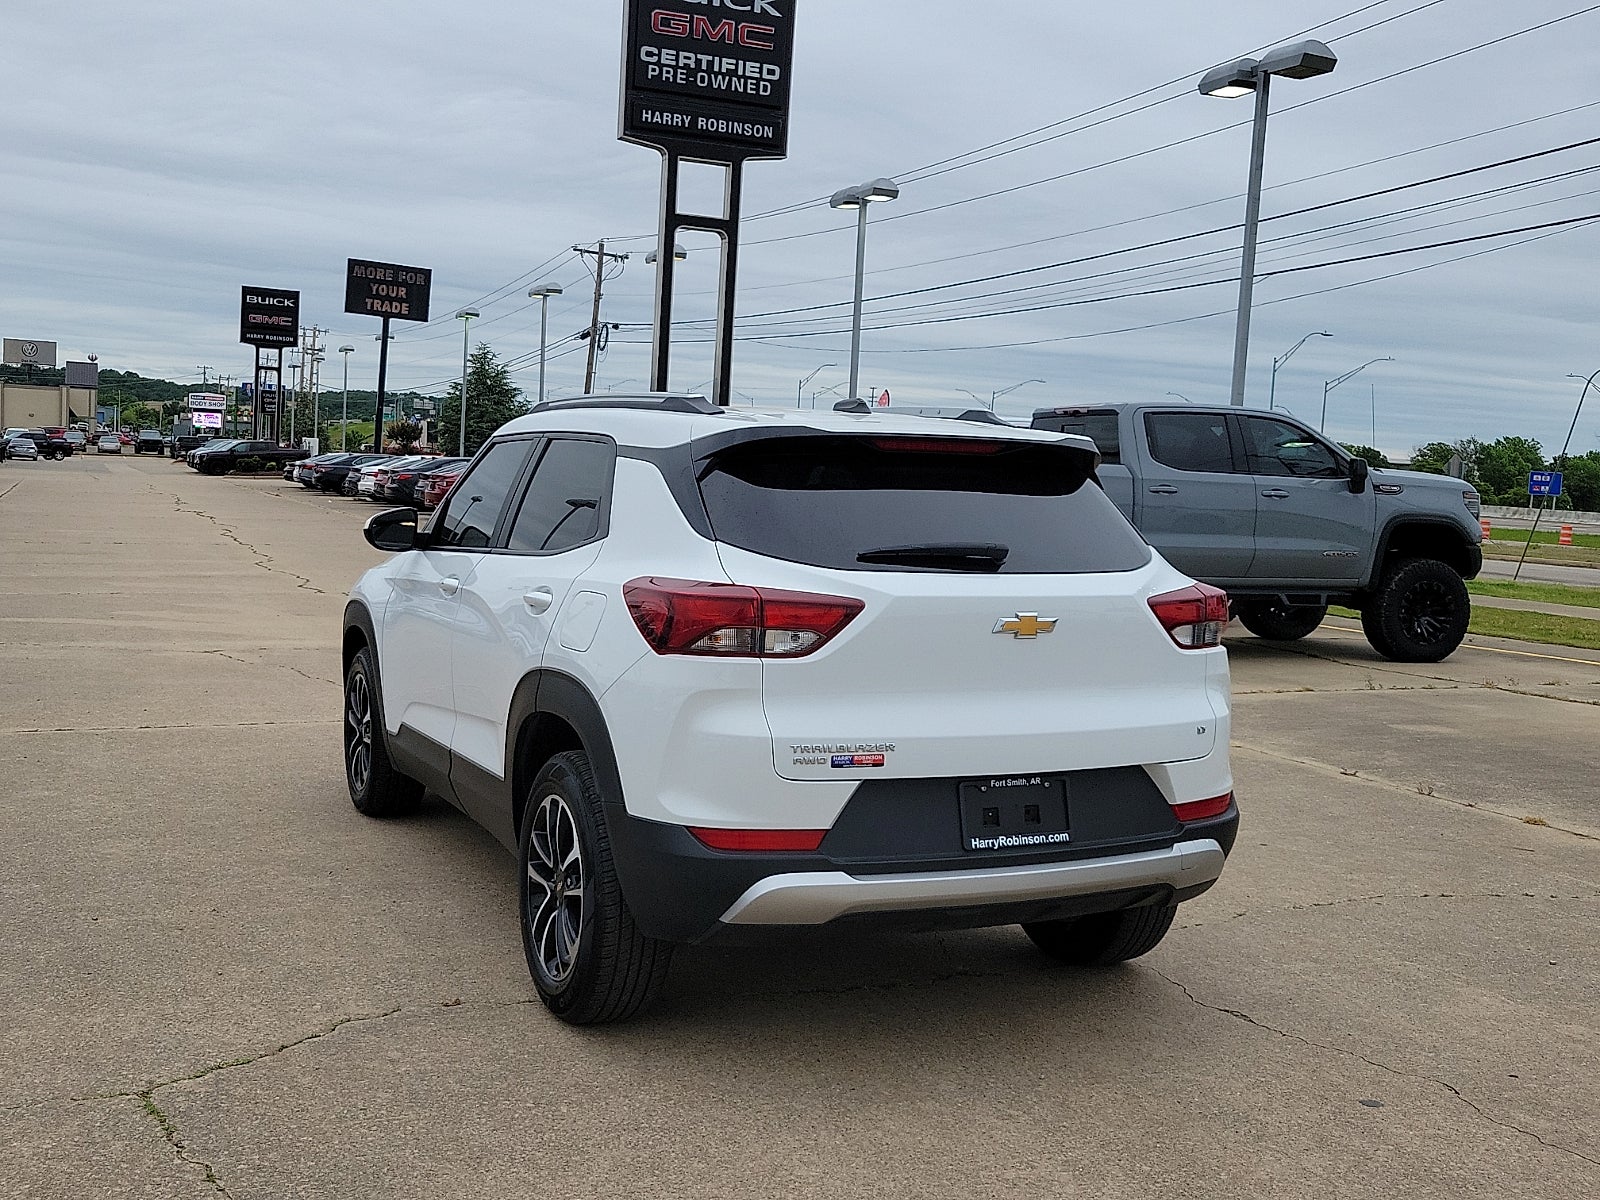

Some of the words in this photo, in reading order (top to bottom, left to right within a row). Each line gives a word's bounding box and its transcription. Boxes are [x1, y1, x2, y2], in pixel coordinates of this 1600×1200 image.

[652, 9, 775, 50] GMC
[640, 45, 781, 81] CERTIFIED
[647, 64, 772, 96] PRE-OWNED
[642, 109, 692, 128] HARRY
[697, 117, 774, 139] ROBINSON
[352, 265, 394, 281] MORE
[398, 271, 426, 285] FOR
[370, 283, 407, 299] YOUR
[246, 295, 295, 307] BUICK
[365, 298, 410, 315] TRADE
[248, 314, 293, 326] GMC
[790, 742, 896, 754] TRAILBLAZER
[792, 756, 828, 766] AWD
[990, 779, 1006, 788] Fort
[1006, 778, 1029, 787] Smith,
[1030, 777, 1041, 785] AR
[971, 832, 1070, 850] HarryRobinson.com
